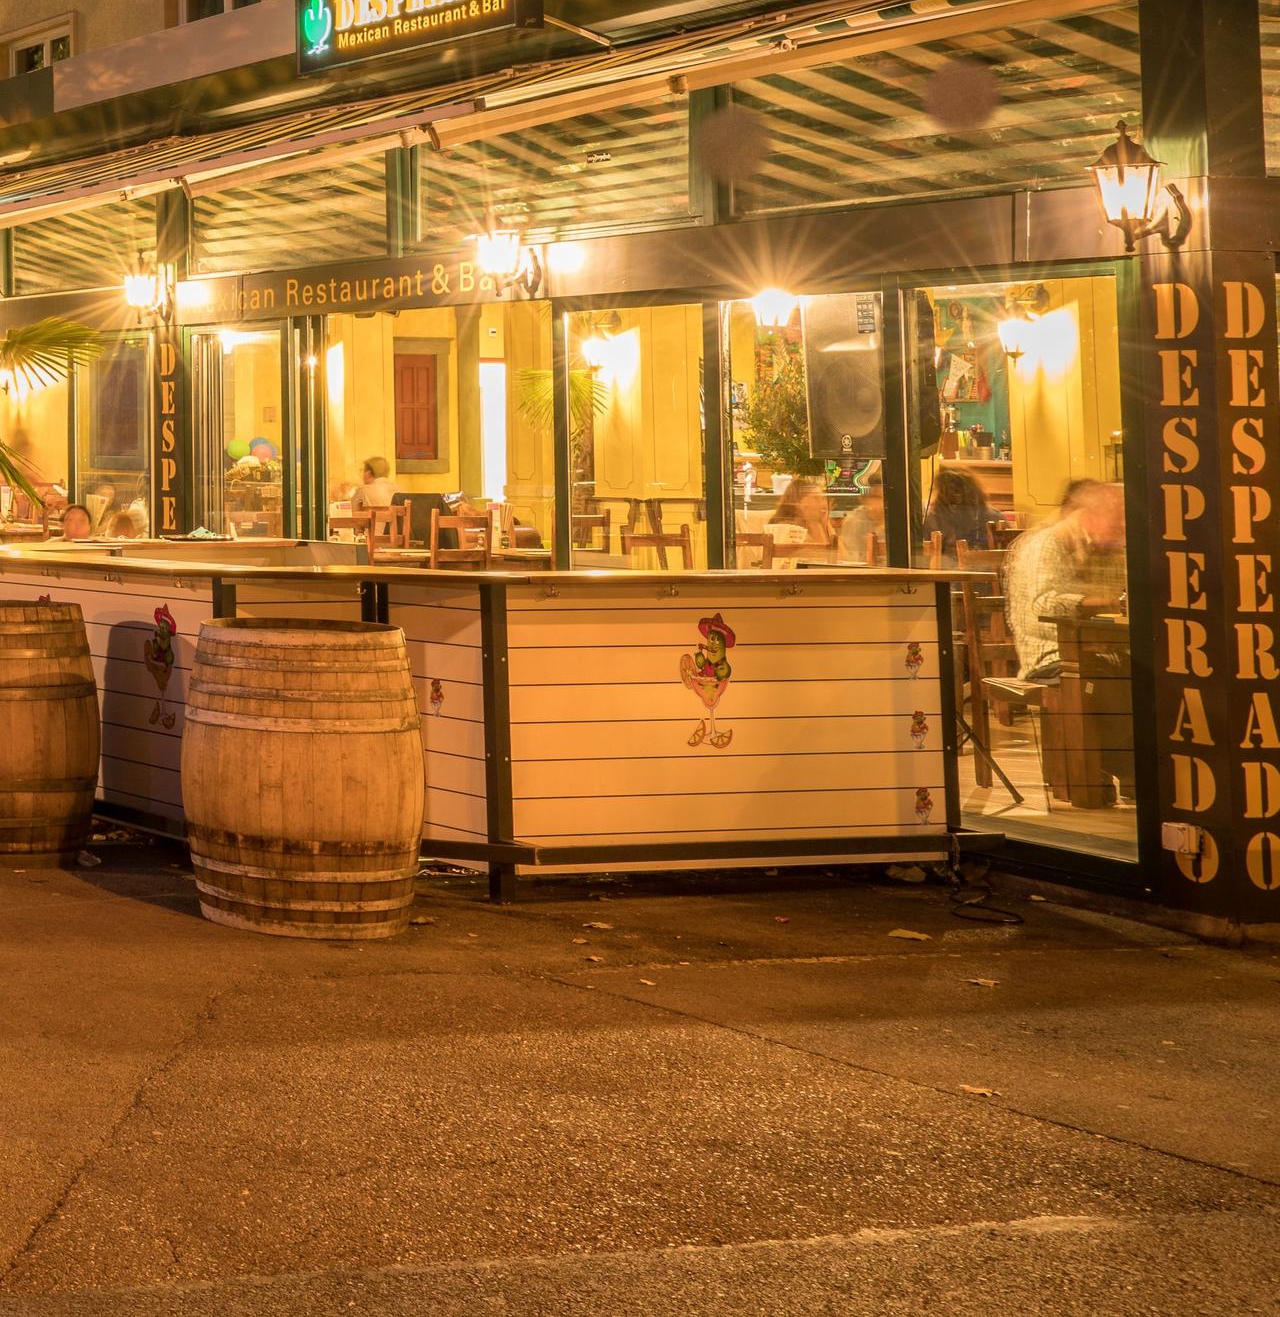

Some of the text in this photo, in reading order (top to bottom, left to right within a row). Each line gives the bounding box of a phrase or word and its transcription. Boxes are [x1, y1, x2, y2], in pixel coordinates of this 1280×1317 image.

[338, 27, 390, 49] Mexican
[394, 5, 467, 34] Restaurant
[469, 0, 480, 15] &
[185, 261, 496, 315] xican Restaurant & Ba
[1152, 282, 1220, 883] DESPERADO
[1222, 282, 1280, 890] DESPERADO
